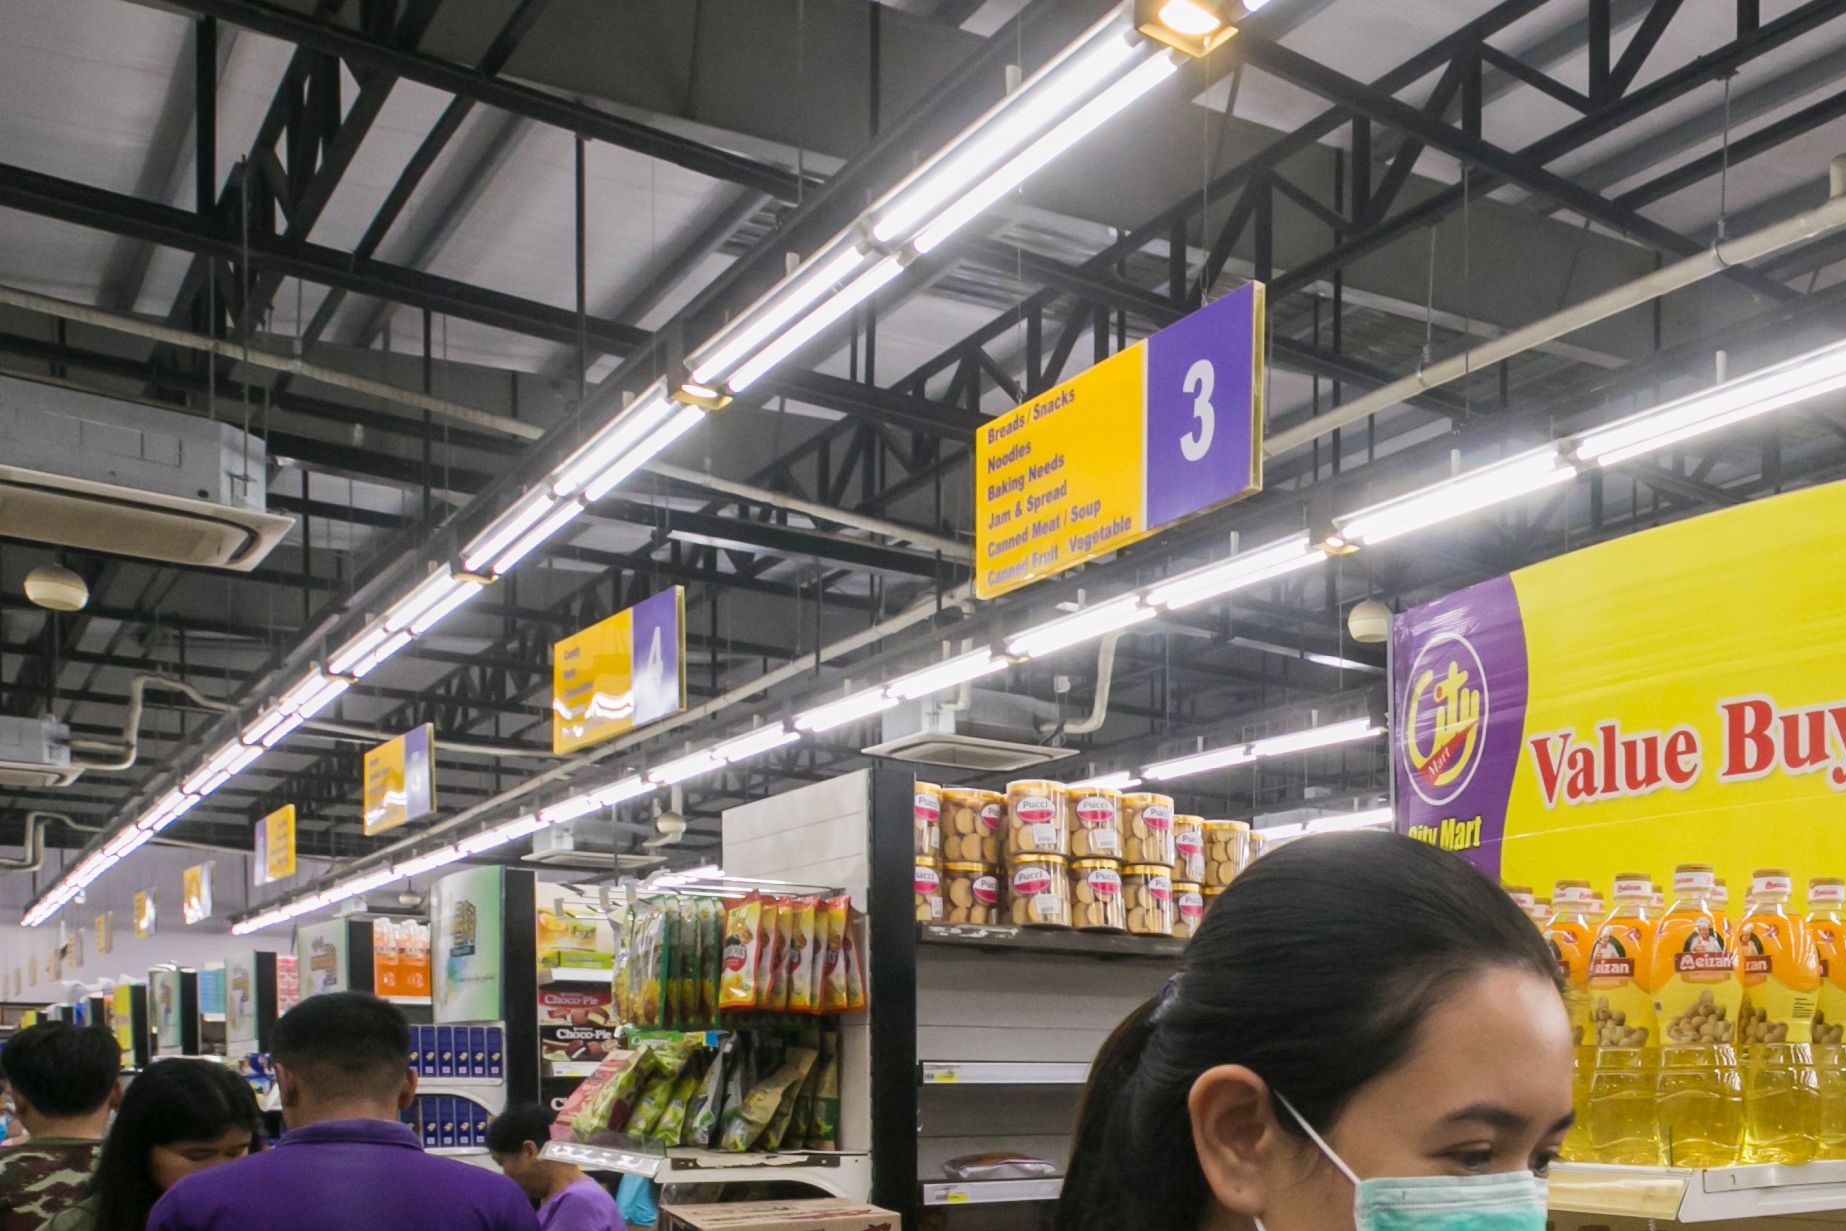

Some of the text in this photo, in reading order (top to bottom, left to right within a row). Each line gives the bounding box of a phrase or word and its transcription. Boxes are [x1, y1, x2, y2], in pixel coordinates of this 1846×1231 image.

[988, 414, 1025, 445] Breads
[1033, 389, 1075, 420] Snacks
[1180, 359, 1215, 461] 3
[988, 441, 1031, 473] Noodles
[988, 453, 1064, 501] Baking Needs
[988, 480, 1067, 530] Jam & Spread
[988, 528, 1028, 558] Canned
[1032, 515, 1060, 539] Meat
[1071, 500, 1101, 524] Soup
[988, 515, 1132, 587] Canned Fruit Vegetable
[1407, 660, 1480, 786] City
[1428, 747, 1450, 776] Mart
[1530, 724, 1698, 807] Value
[1083, 801, 1108, 809] Pucci
[1440, 816, 1482, 850] Mart
[1019, 870, 1042, 880] Pucci
[1680, 953, 1732, 970] Meizan
